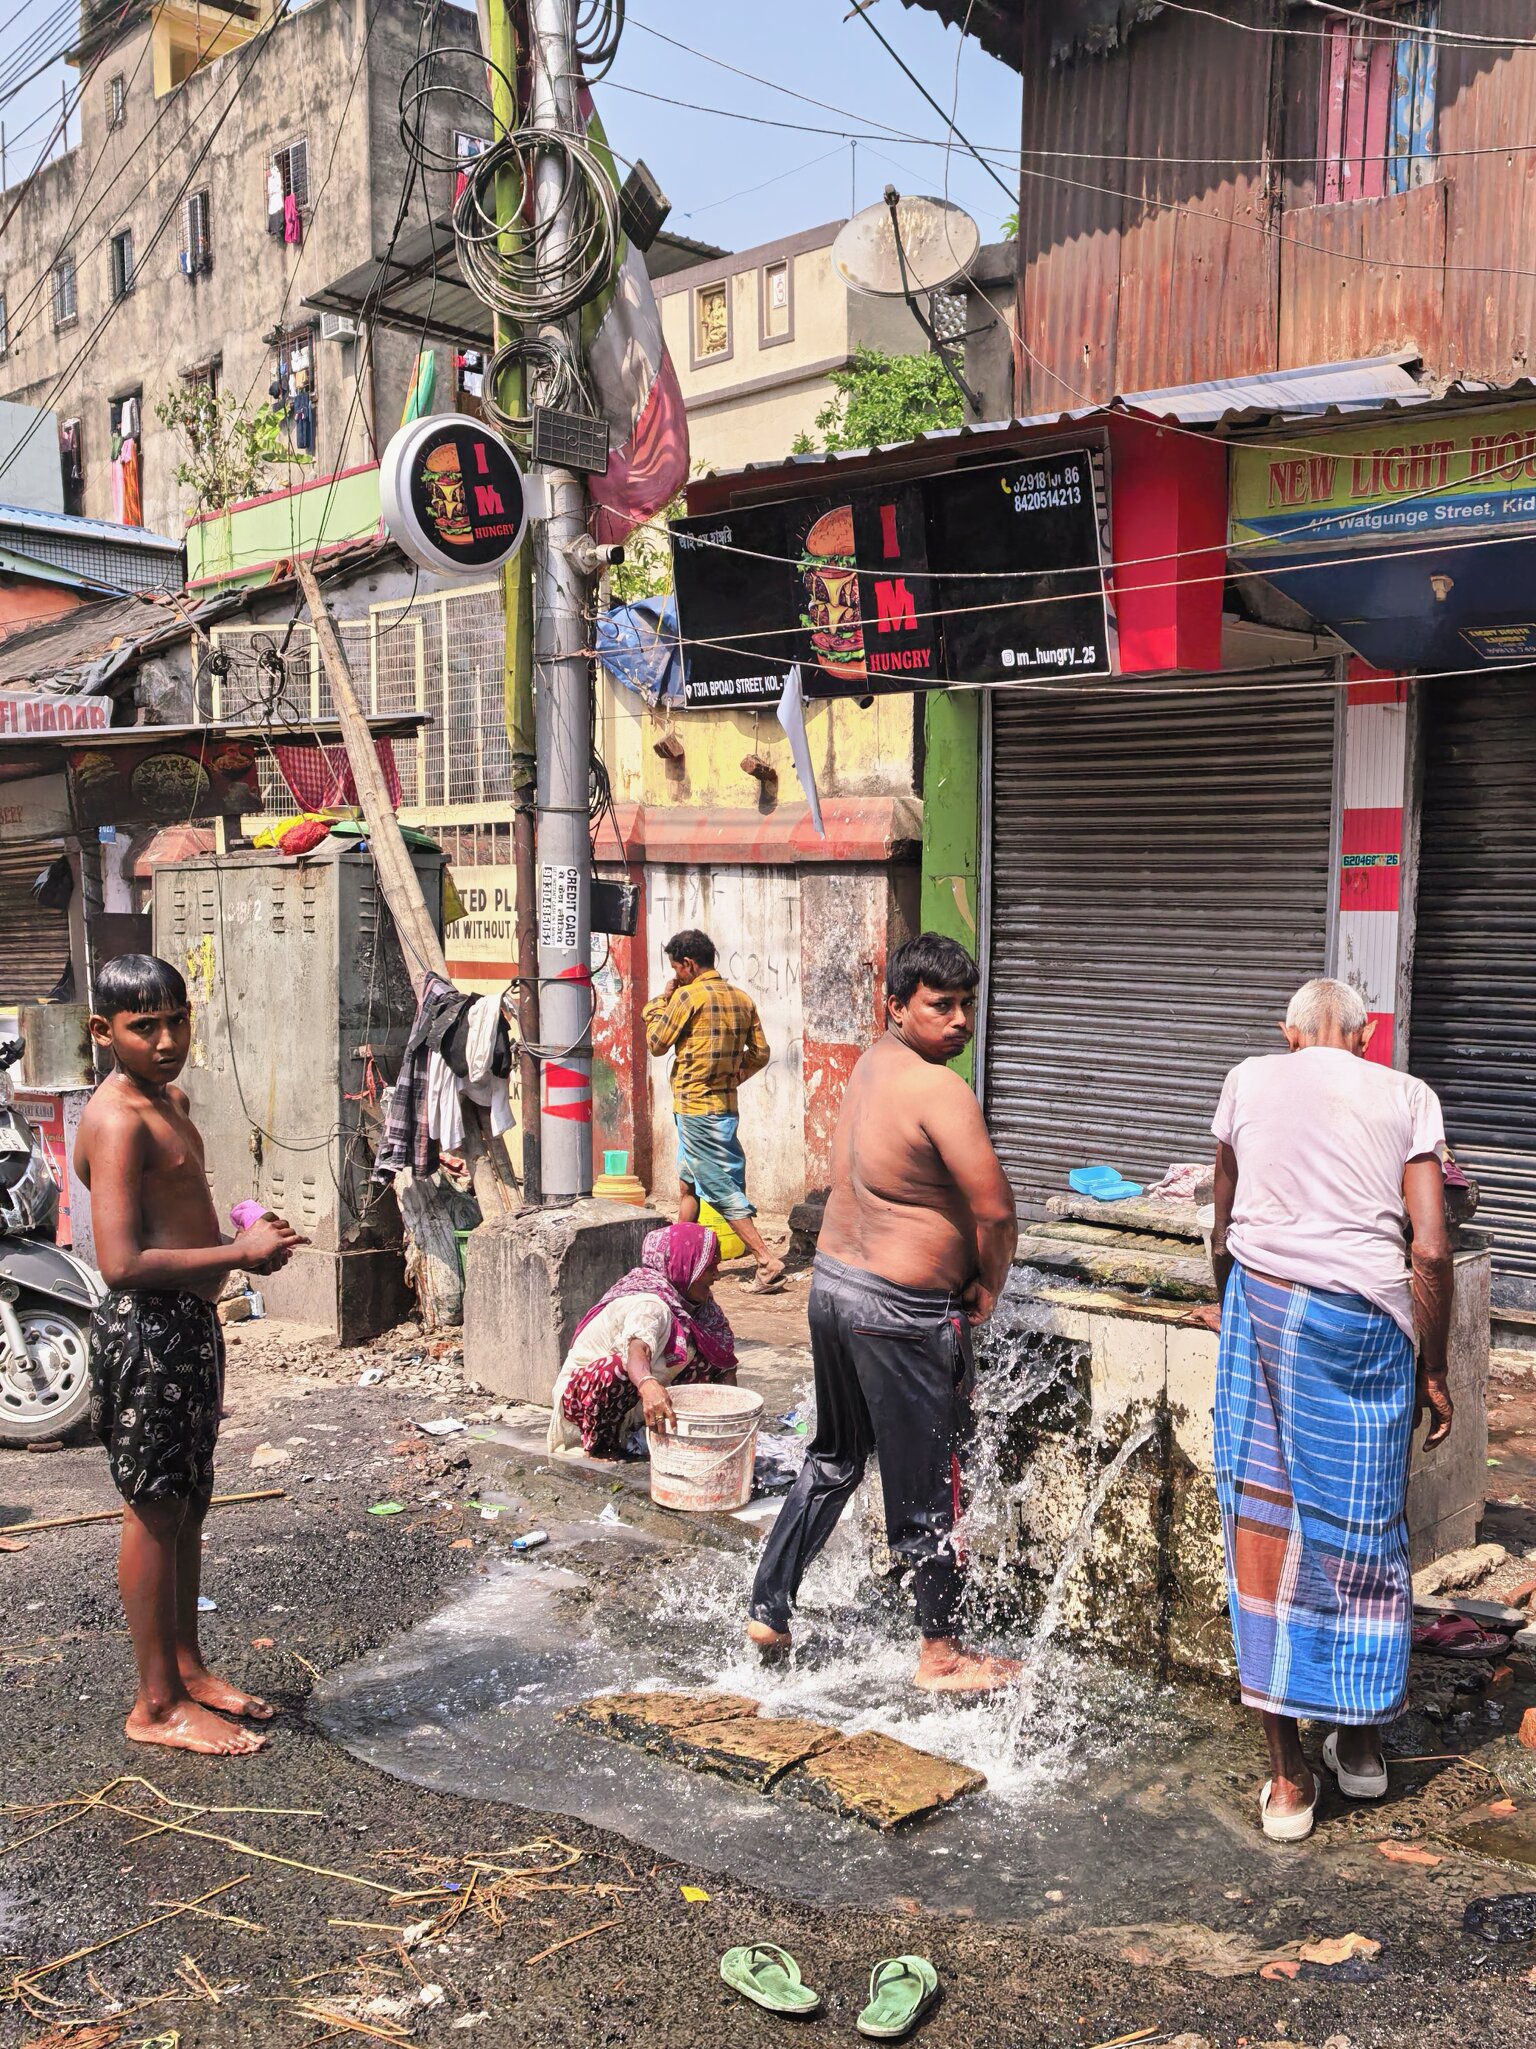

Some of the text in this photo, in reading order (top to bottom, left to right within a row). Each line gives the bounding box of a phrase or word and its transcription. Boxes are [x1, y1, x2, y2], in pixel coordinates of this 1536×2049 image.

[473, 443, 489, 474] I
[1267, 456, 1338, 508] NEW
[1350, 440, 1456, 498] LIGHT
[473, 485, 505, 516] M
[1014, 486, 1082, 512] 8420514213
[1434, 502, 1496, 520] Street,
[474, 523, 514, 540] HUNGRY
[880, 504, 900, 559] I
[874, 578, 918, 633] M
[869, 649, 931, 672] HUNGRY
[736, 677, 764, 694] STREET,
[495, 888, 518, 912] PL
[565, 868, 578, 946] CREDIT CARD
[463, 920, 511, 939] WITHOUT
